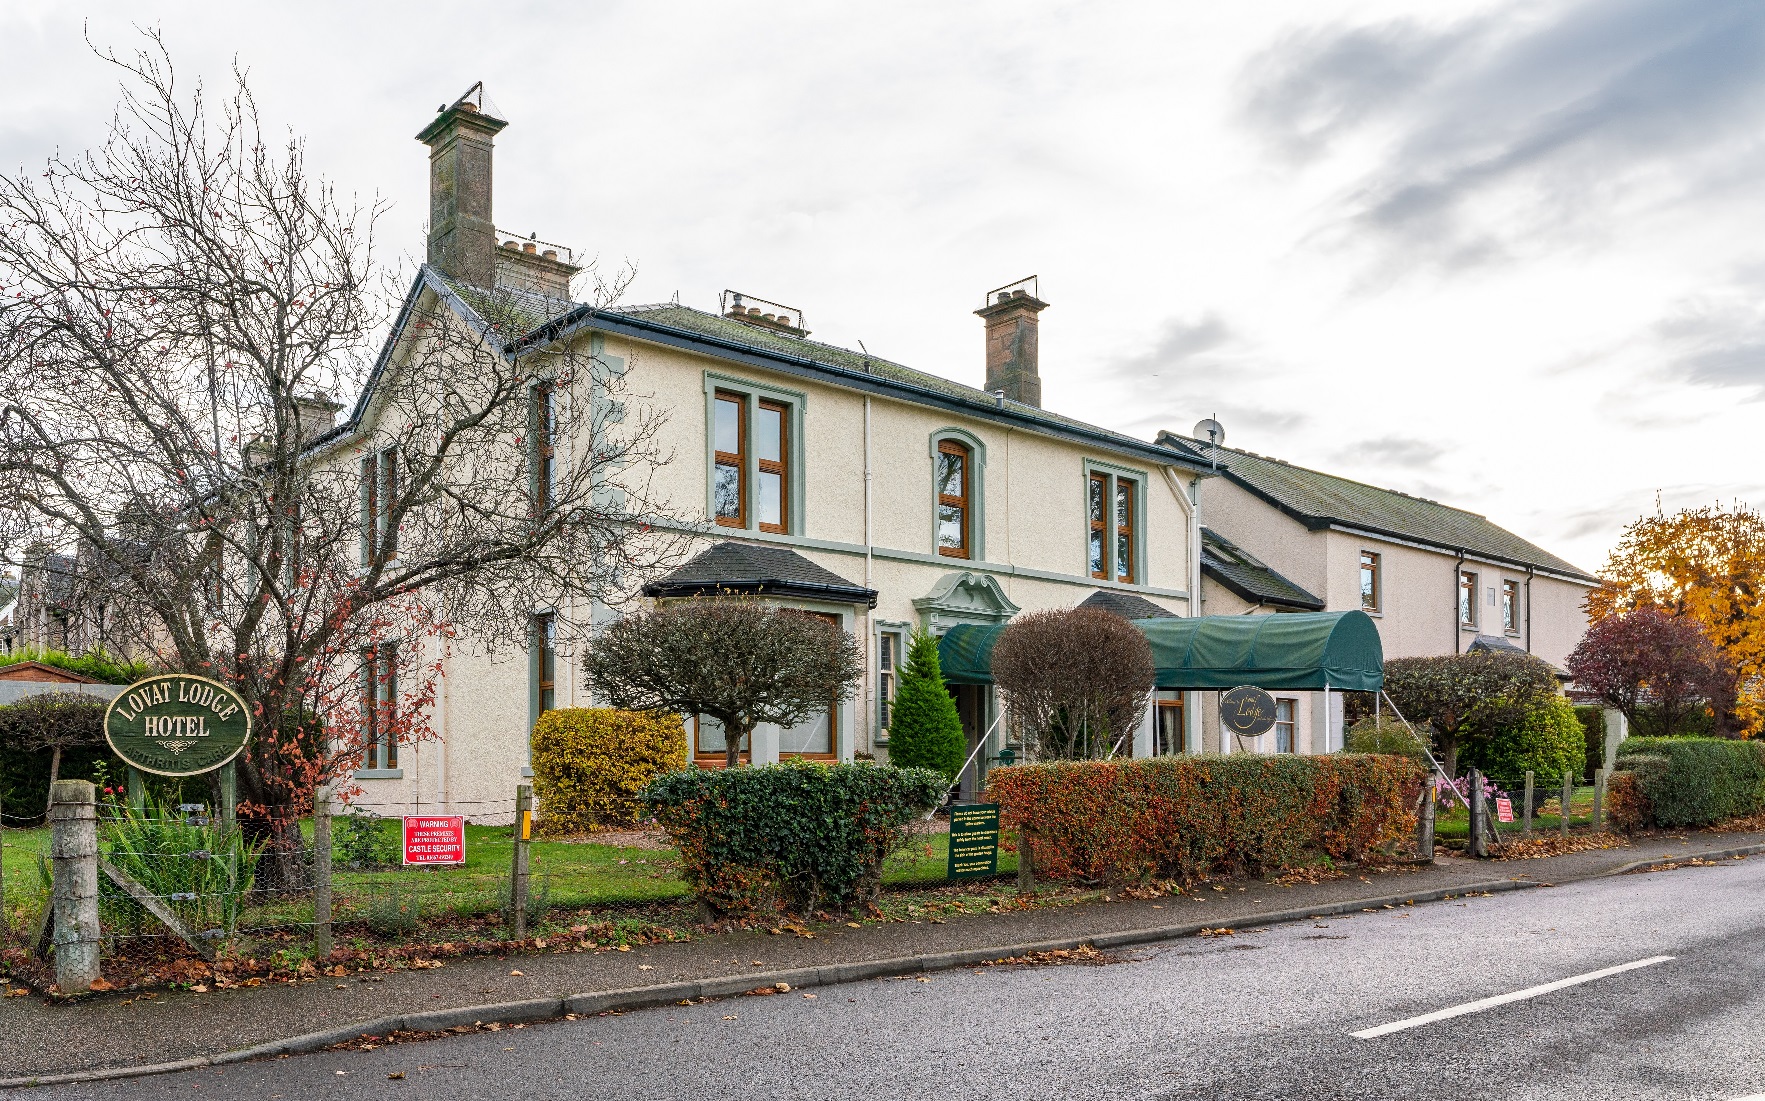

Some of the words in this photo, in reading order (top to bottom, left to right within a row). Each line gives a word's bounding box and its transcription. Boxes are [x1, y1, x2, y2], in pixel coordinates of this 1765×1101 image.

[115, 681, 171, 722] LOVAT
[178, 681, 239, 722] LODGE
[144, 715, 210, 737] HOTEL
[125, 747, 191, 770] ARTHRITIS
[197, 744, 230, 767] CARE
[419, 820, 449, 828] WARNING
[408, 845, 431, 853] CASTLE
[432, 844, 461, 852] SECURITY
